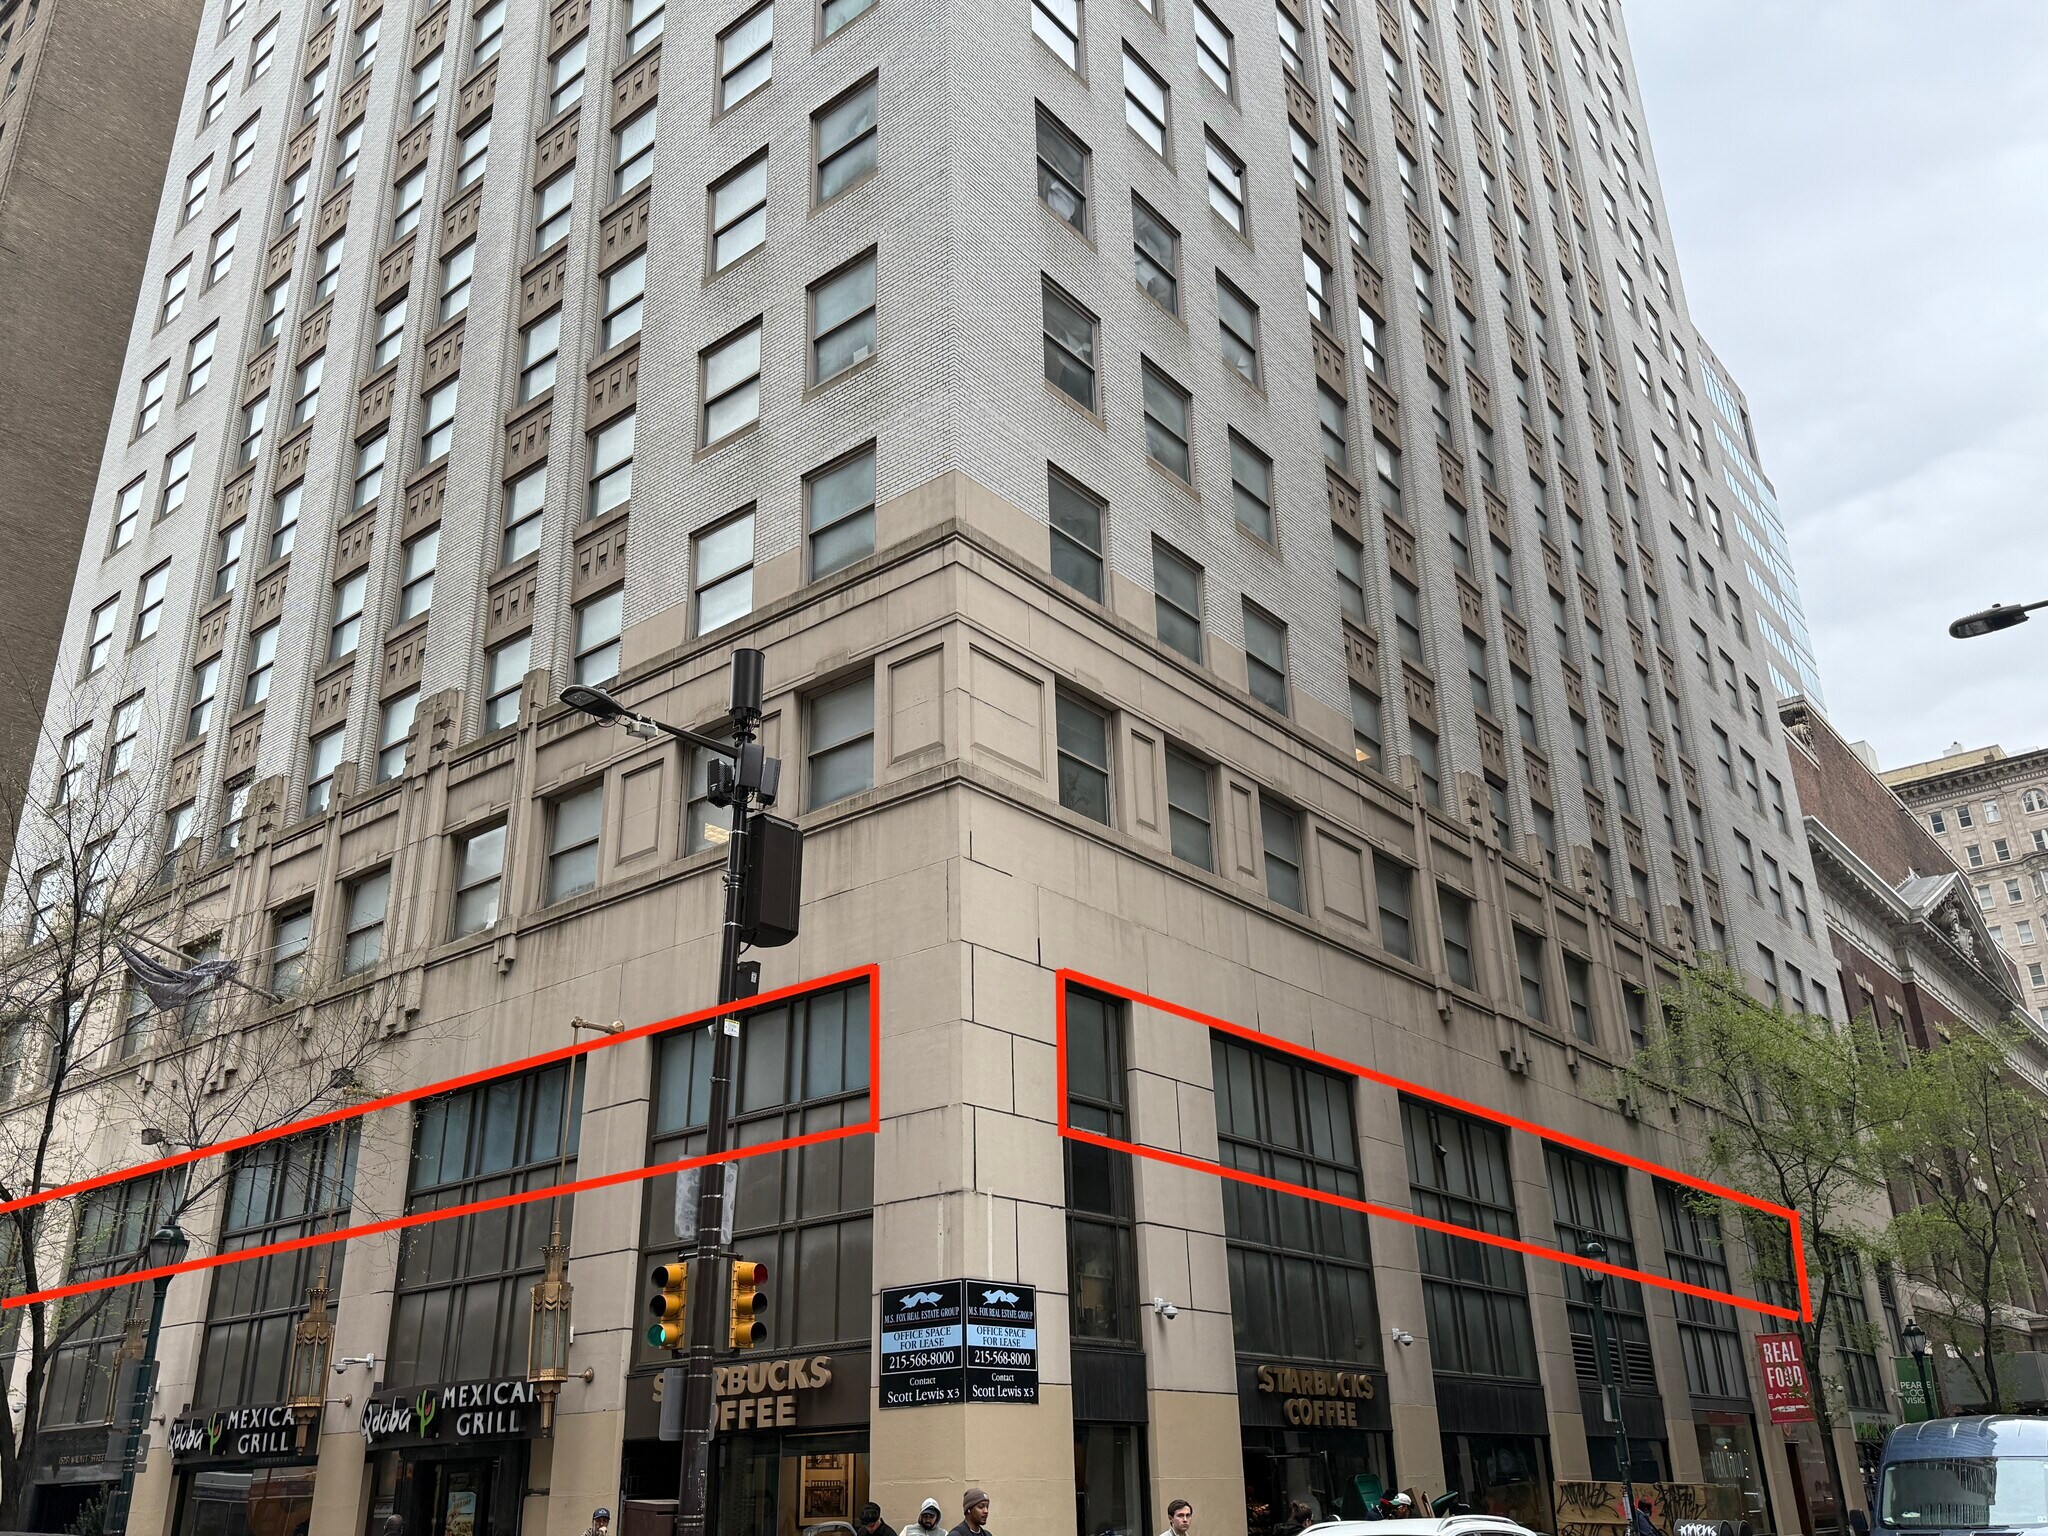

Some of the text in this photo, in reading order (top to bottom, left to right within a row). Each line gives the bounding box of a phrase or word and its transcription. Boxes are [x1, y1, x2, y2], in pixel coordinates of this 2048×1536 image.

[885, 1307, 959, 1323] M.S. FOX REAL ESTATE GROUP
[969, 1306, 1033, 1320] M.S. FOX REAL ESTATE GROUP
[894, 1327, 951, 1341] OFFICE SPACE
[976, 1326, 1026, 1338] OFFICE SPACE
[900, 1338, 944, 1350] FOR LEASE
[982, 1337, 1021, 1347] FOR LEASE
[889, 1350, 955, 1369] 215-568-8000
[974, 1350, 1031, 1366] 215-568-8000
[1763, 1341, 1799, 1363] REAL
[652, 1356, 832, 1403] SRBUCKS
[909, 1377, 936, 1386] Contact
[991, 1372, 1014, 1382] Contact
[1258, 1365, 1374, 1400] STARBUCKS
[1766, 1365, 1803, 1388] FOOD
[972, 1385, 1034, 1397] Scott Lewis x3
[1900, 1381, 1931, 1389] PEARE
[887, 1388, 960, 1403] Scott Lewis x3
[227, 1407, 295, 1430] MEXICA
[359, 1396, 412, 1444] Qdoba
[714, 1395, 797, 1430] FFEE
[1284, 1398, 1357, 1427] COFFEE
[456, 1410, 520, 1436] GRILL
[167, 1417, 204, 1459] Qdoba
[238, 1431, 289, 1454] GRILL
[91, 1453, 106, 1462] STREE
